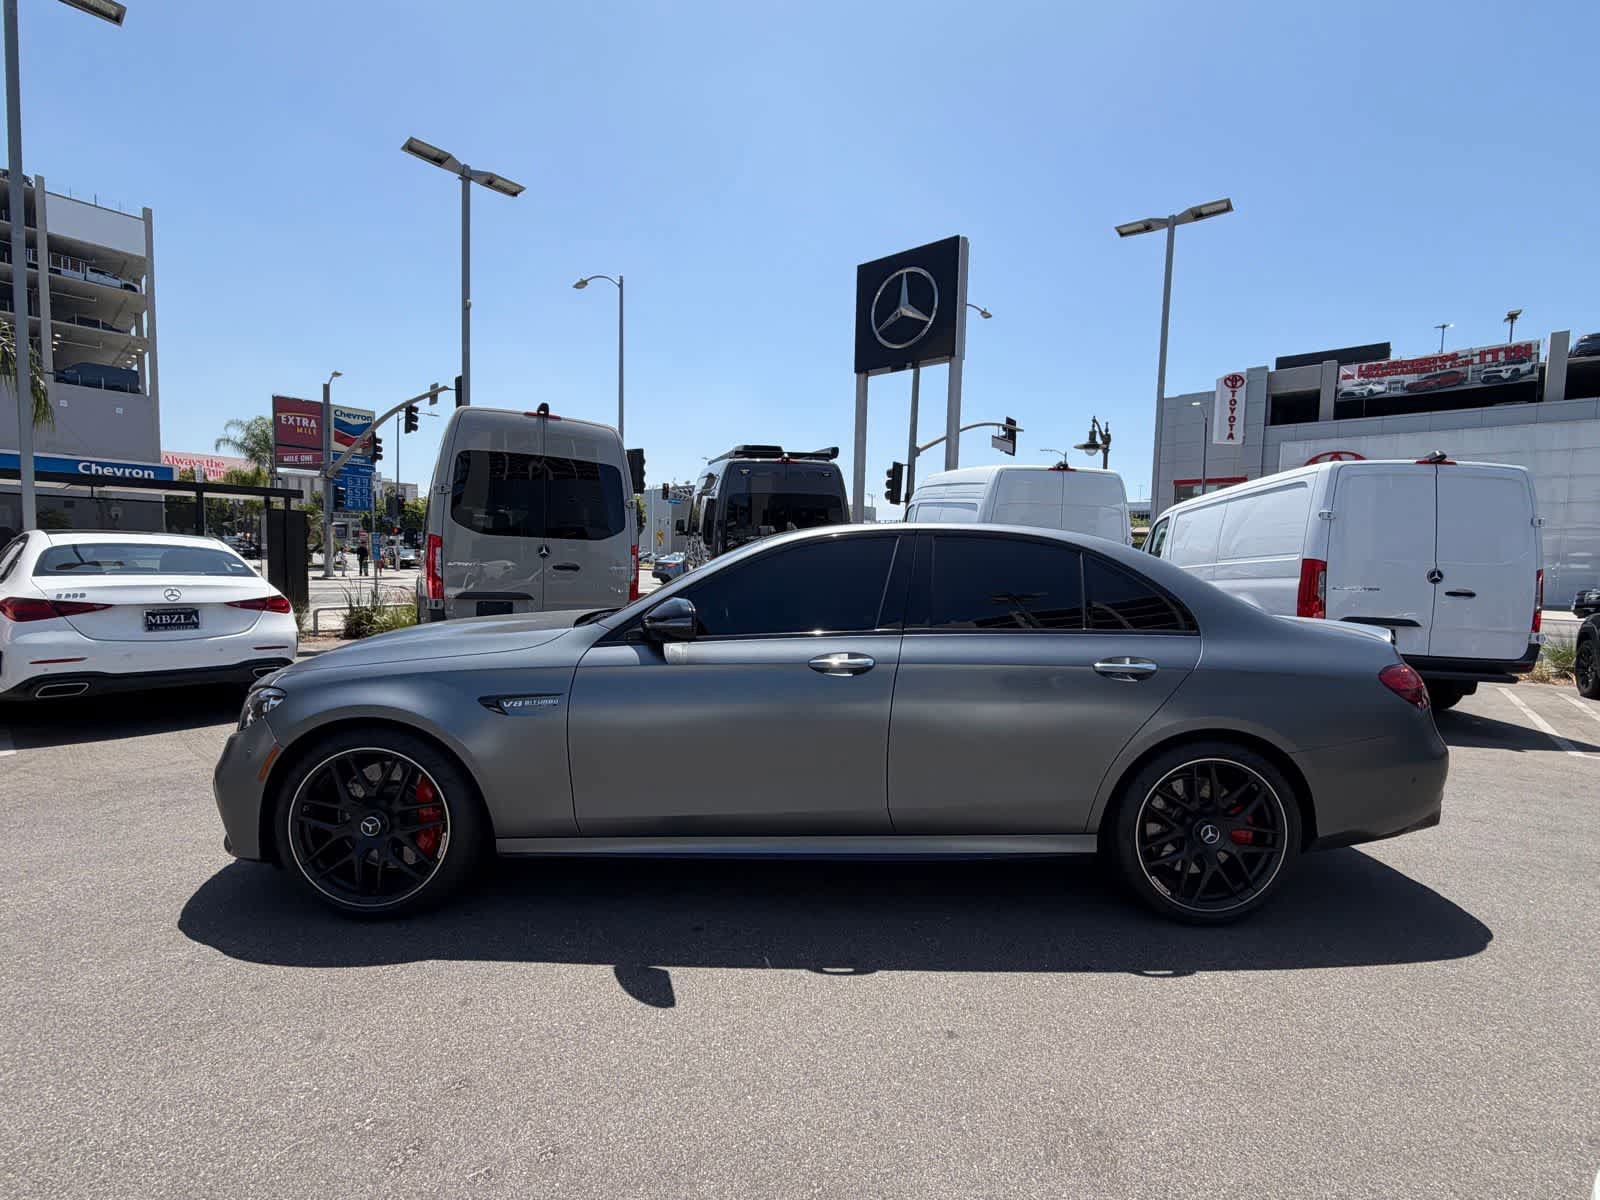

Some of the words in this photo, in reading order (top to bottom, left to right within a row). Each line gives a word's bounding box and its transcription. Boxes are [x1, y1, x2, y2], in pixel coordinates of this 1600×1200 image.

[1479, 344, 1532, 363] ITIN
[281, 414, 317, 428] EXTRA
[334, 409, 373, 421] Chevron
[1227, 390, 1237, 440] TOYOTA
[164, 455, 205, 467] Always
[206, 458, 225, 468] the
[77, 462, 155, 479] Chevron
[147, 614, 199, 625] MBZLA
[503, 700, 523, 708] V8
